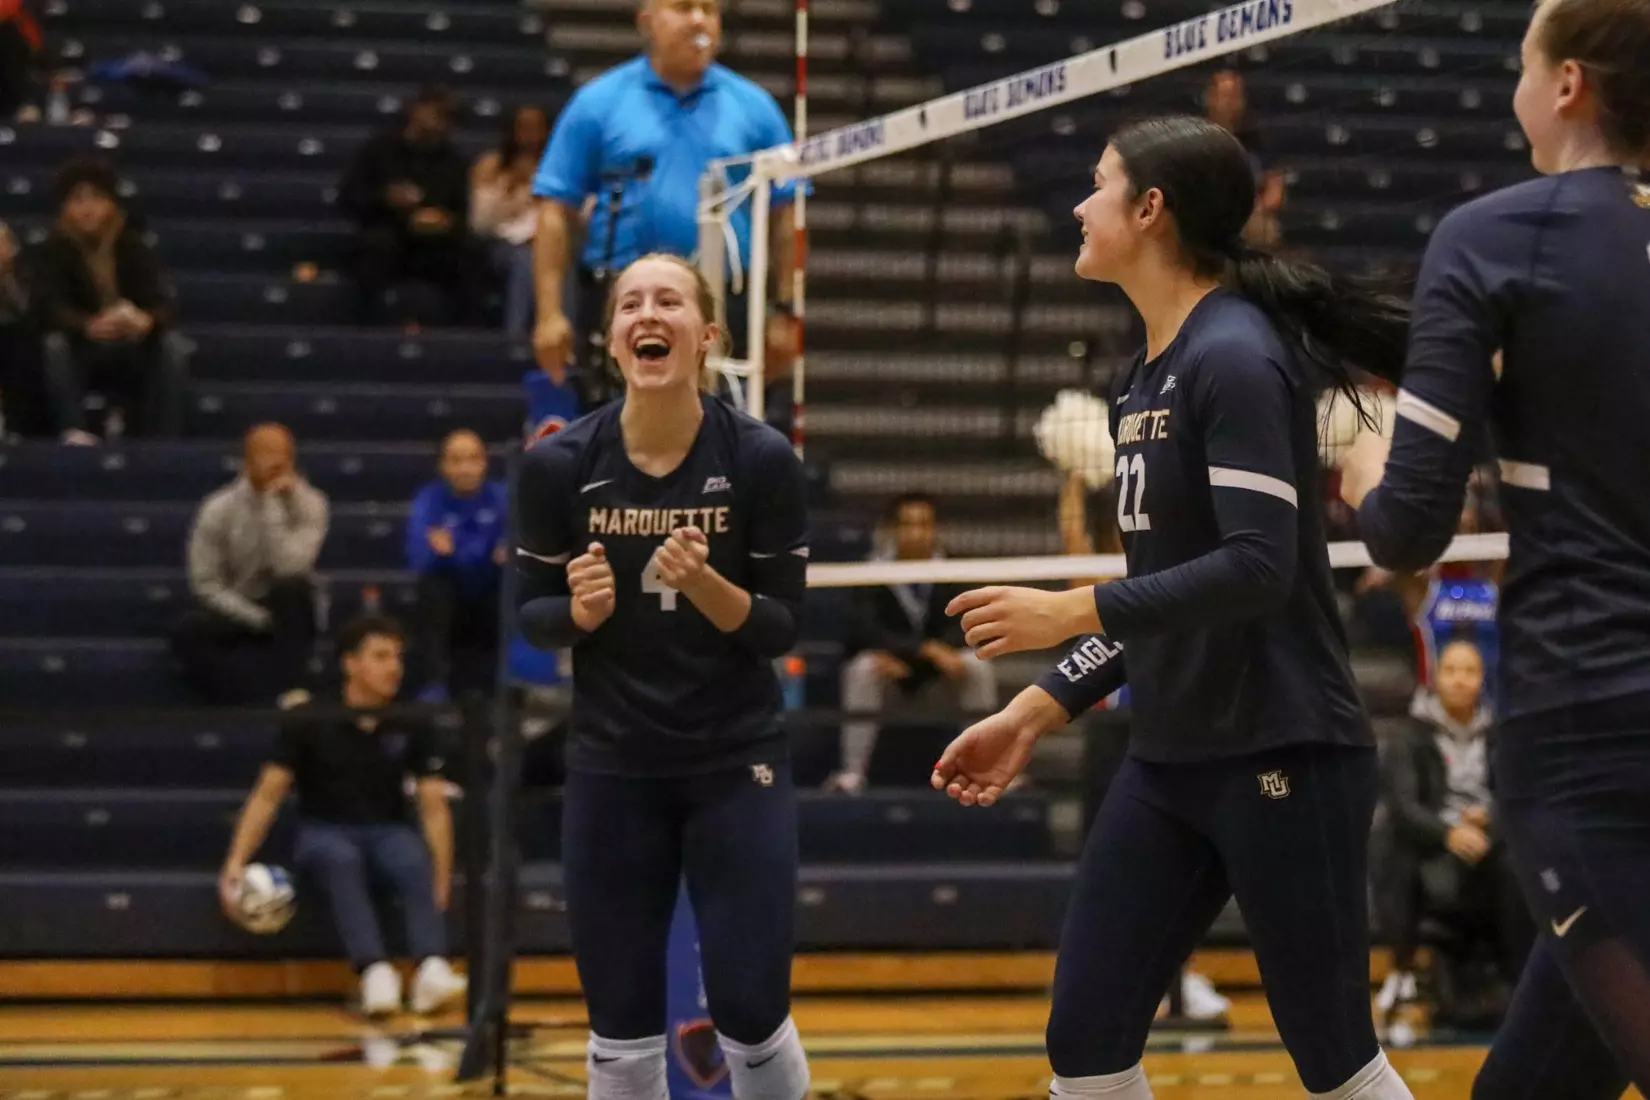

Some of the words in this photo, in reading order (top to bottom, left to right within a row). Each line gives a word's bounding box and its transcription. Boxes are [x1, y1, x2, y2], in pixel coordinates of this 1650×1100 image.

[1217, 0, 1292, 42] DEMONS
[1116, 453, 1151, 532] 22
[589, 506, 730, 536] MARQUETTE
[641, 545, 680, 612] 4
[1259, 771, 1290, 799] MU
